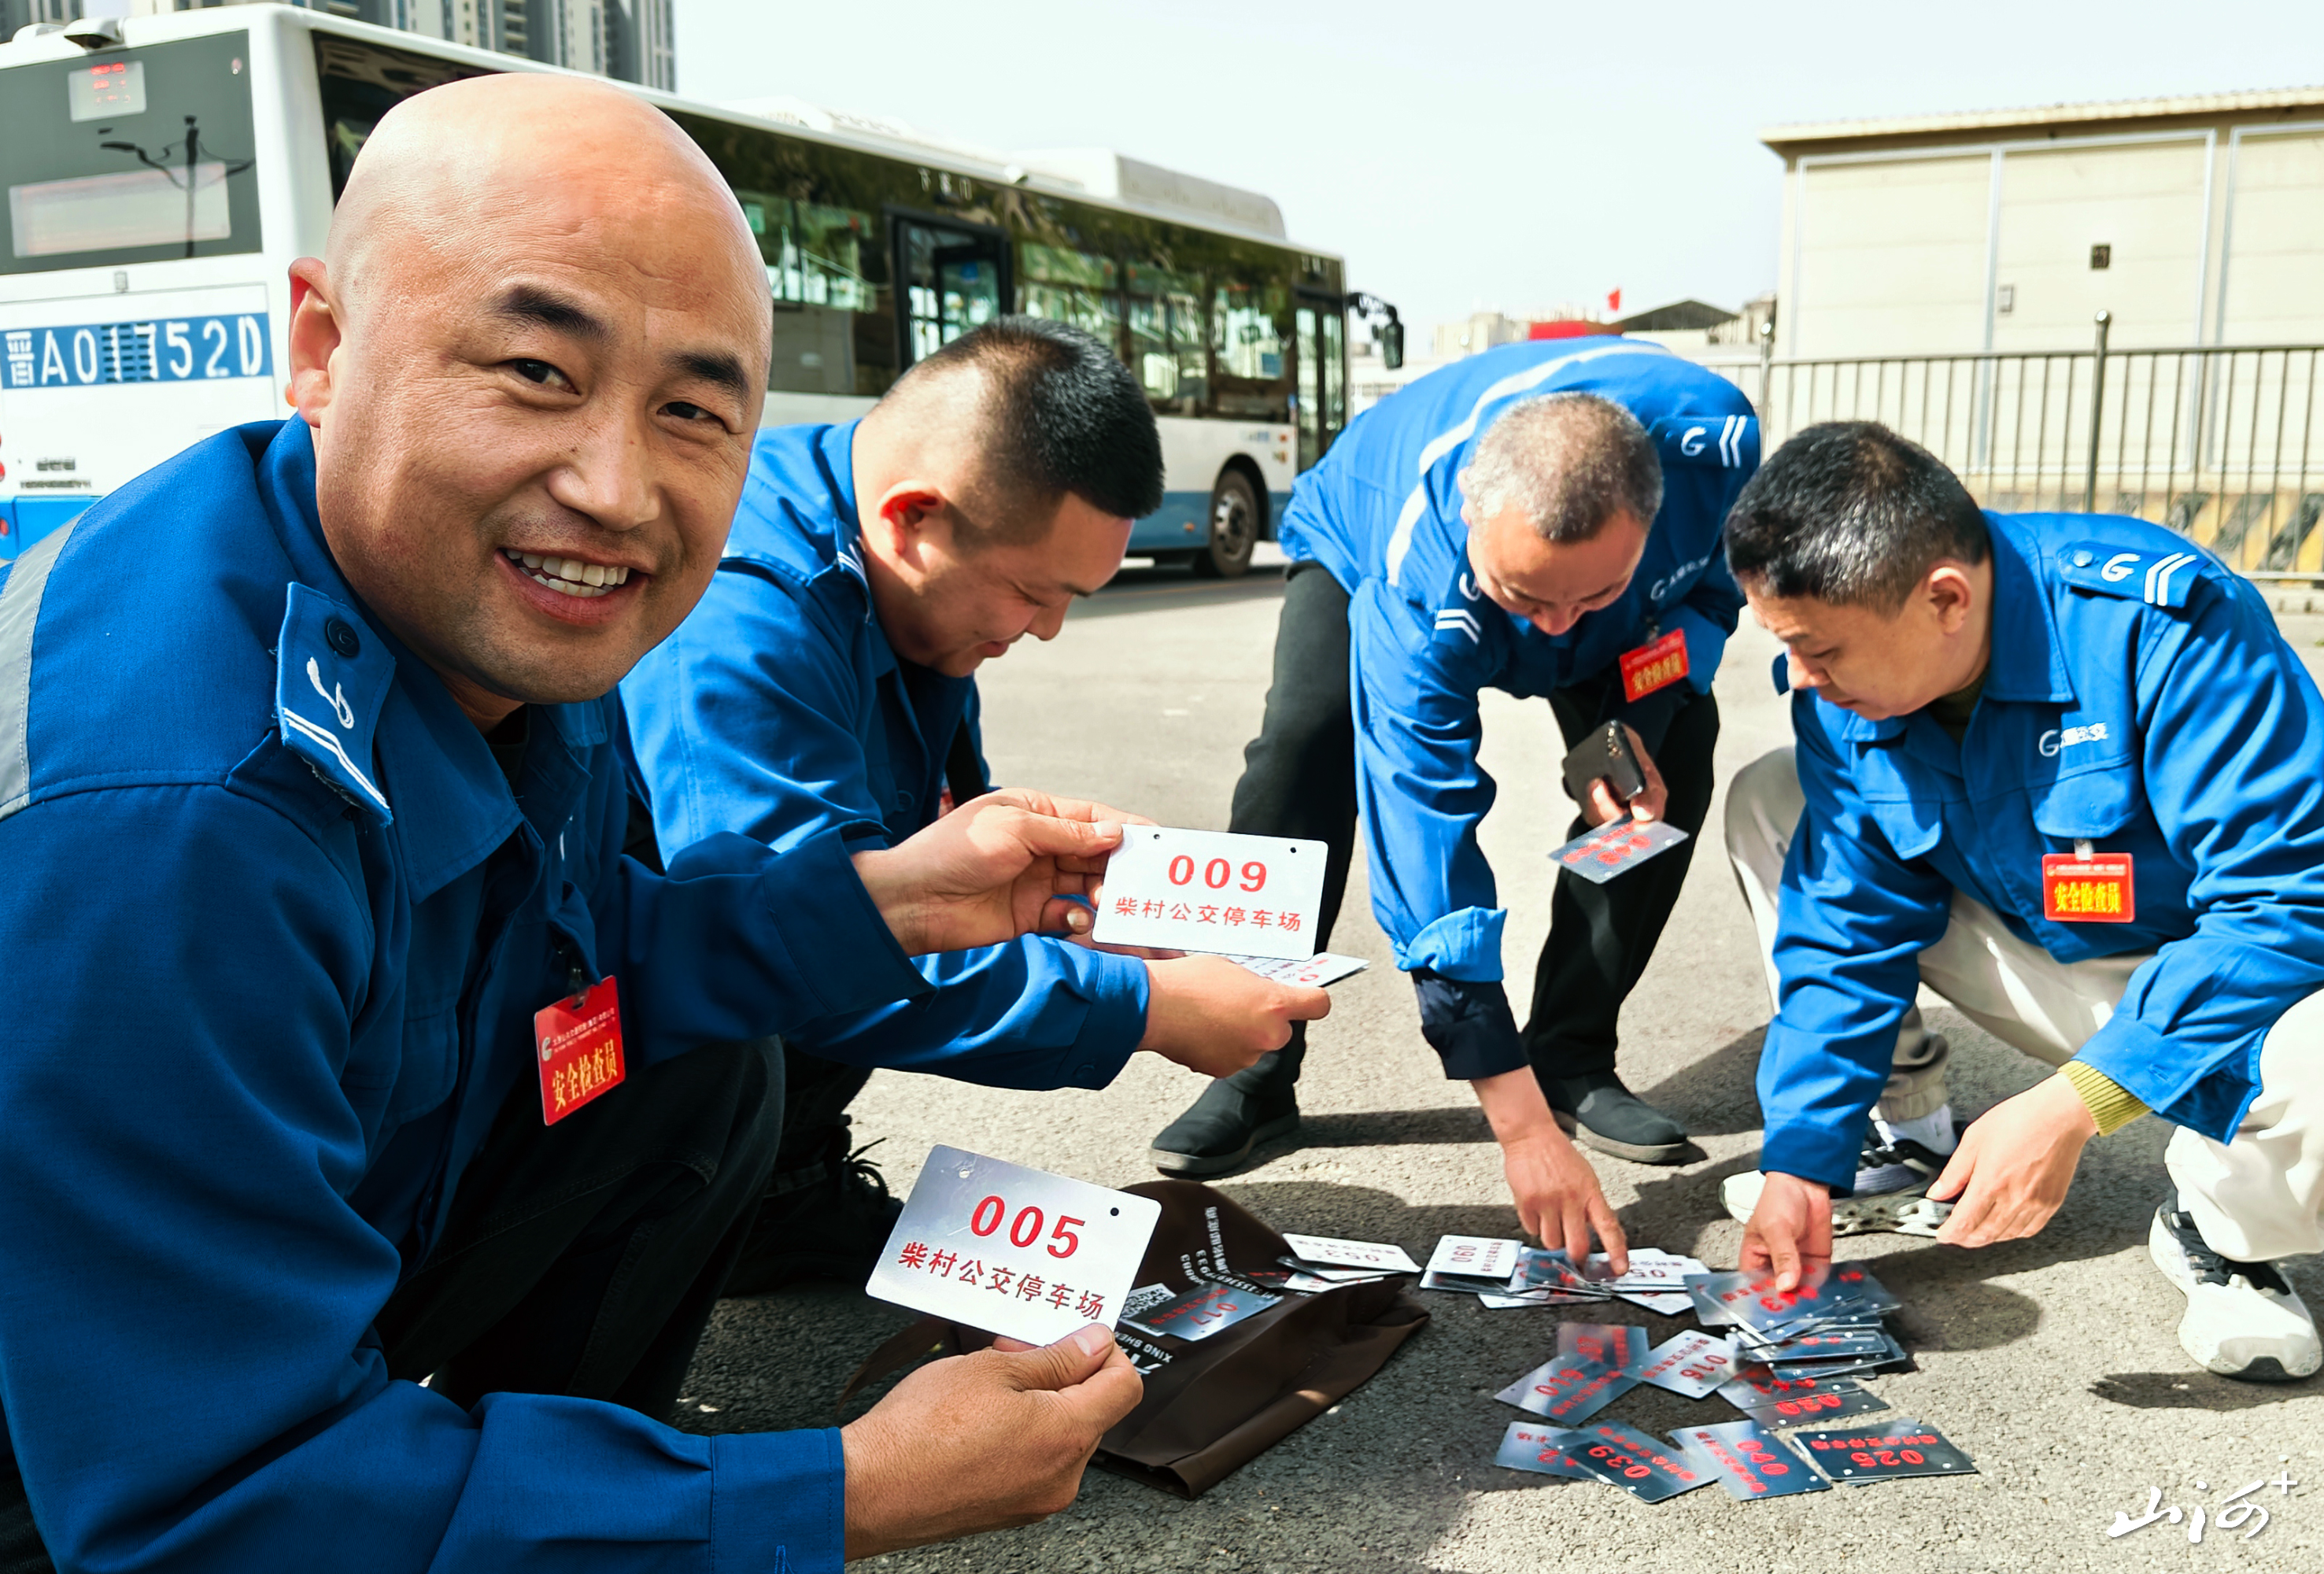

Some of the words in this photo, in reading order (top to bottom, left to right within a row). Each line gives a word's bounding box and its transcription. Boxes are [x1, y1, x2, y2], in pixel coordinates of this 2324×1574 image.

[1168, 855, 1268, 892] 009
[1114, 896, 1301, 932] 柴村公交停车场
[552, 1039, 618, 1112] 安全检查员
[970, 1195, 1085, 1258] 005
[1451, 1245, 1476, 1263] 060
[898, 1242, 1105, 1320] 柴村公交停车场
[1629, 1268, 1666, 1278] 05
[1190, 1302, 1238, 1325] 017
[1143, 1343, 1173, 1363] XING
[1679, 1354, 1727, 1380] 016
[1535, 1369, 1585, 1396] 019
[1587, 1445, 1652, 1479] 039
[1736, 1440, 1790, 1476] 040
[1850, 1449, 1925, 1469] 025
